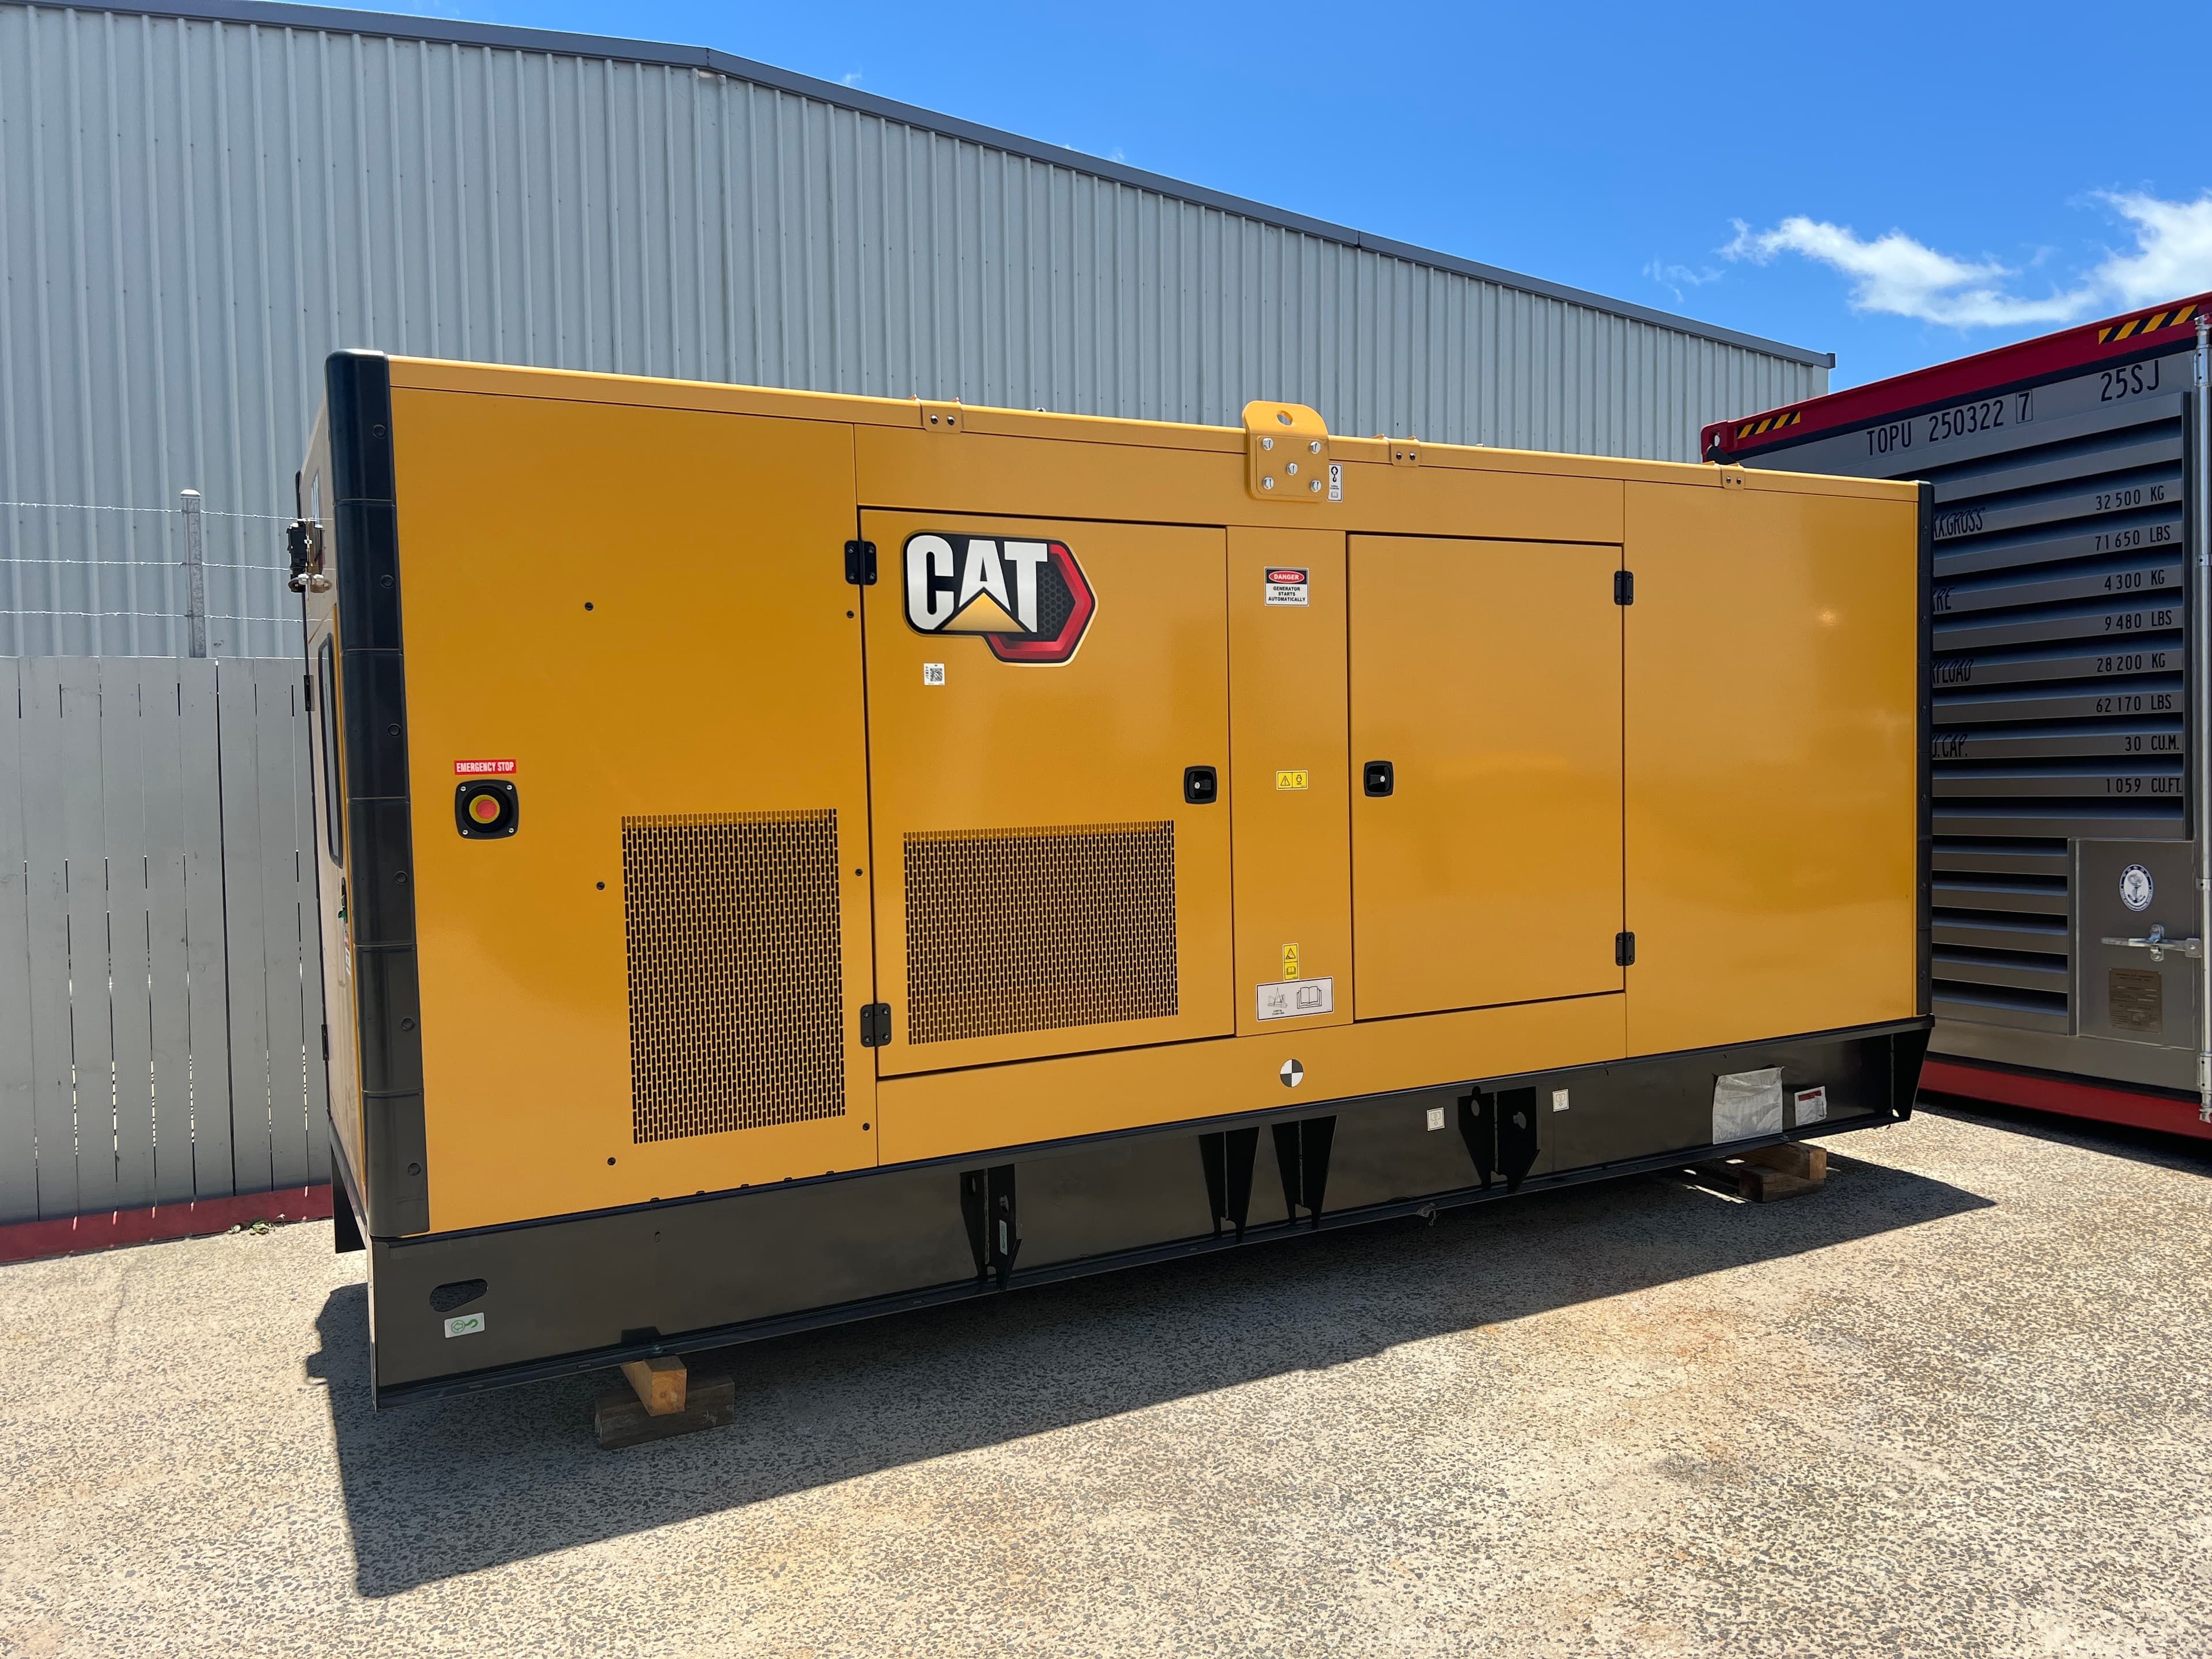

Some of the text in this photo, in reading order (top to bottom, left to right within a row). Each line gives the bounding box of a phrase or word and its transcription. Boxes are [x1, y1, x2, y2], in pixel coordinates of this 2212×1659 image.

[2100, 360, 2160, 402] 25SJ
[1867, 392, 2029, 456] TOPU 250322 7
[2150, 486, 2164, 502] KG
[2150, 525, 2171, 543] LBS
[907, 535, 1048, 633] CAT
[2151, 570, 2165, 585] KG
[2152, 610, 2172, 627] LBS
[2152, 653, 2165, 668] KG
[2151, 694, 2171, 710] LBS
[2125, 735, 2179, 751] 30 CU.M.
[456, 762, 514, 772] EMERGENCY STOP
